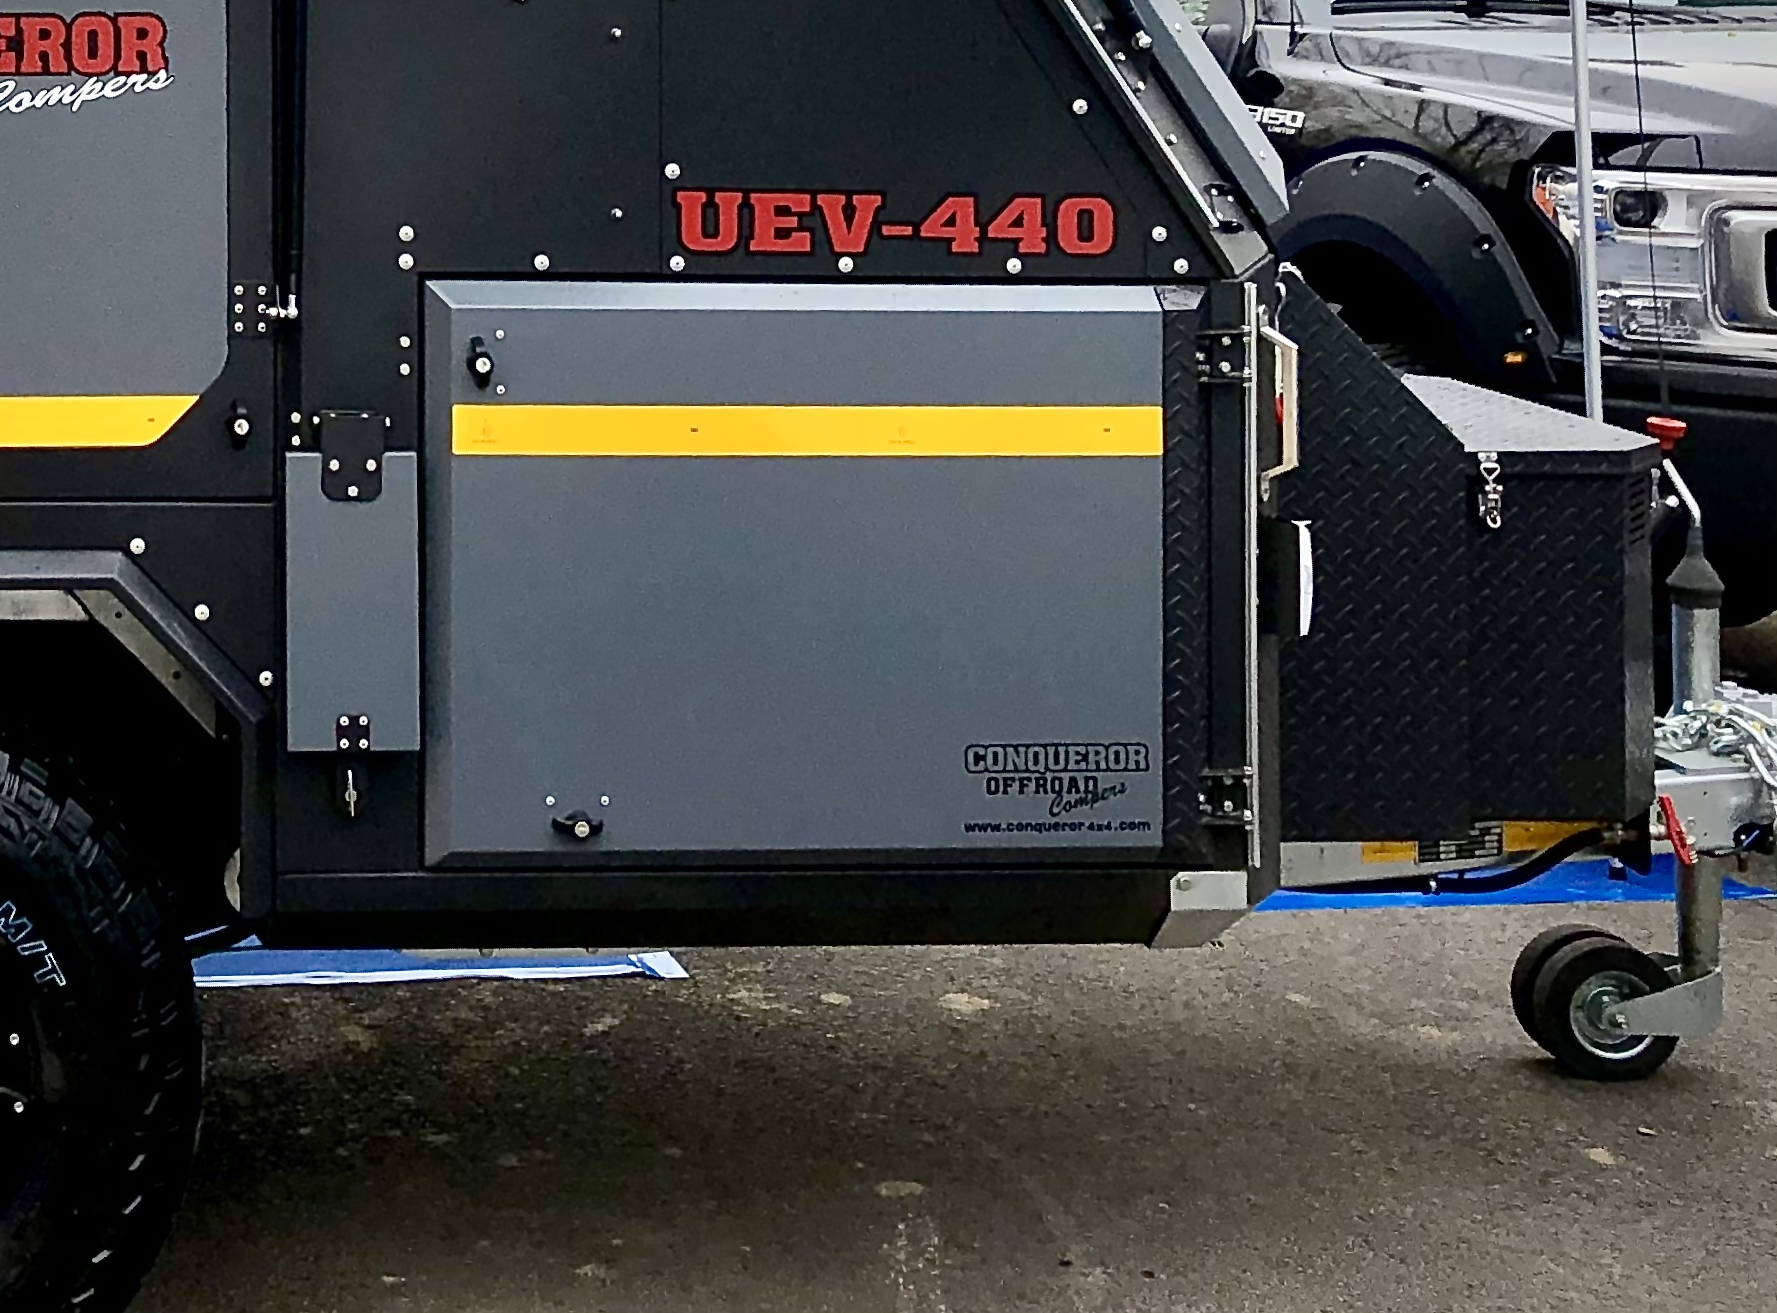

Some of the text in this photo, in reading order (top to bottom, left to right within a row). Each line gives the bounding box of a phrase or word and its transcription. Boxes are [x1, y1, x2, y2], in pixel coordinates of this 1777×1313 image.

[673, 188, 1117, 257] UEV-440
[964, 742, 1150, 774] CONQUEROR
[985, 775, 1099, 796] OFFROAD
[963, 819, 1152, 835] www.conqueror4x4.com
